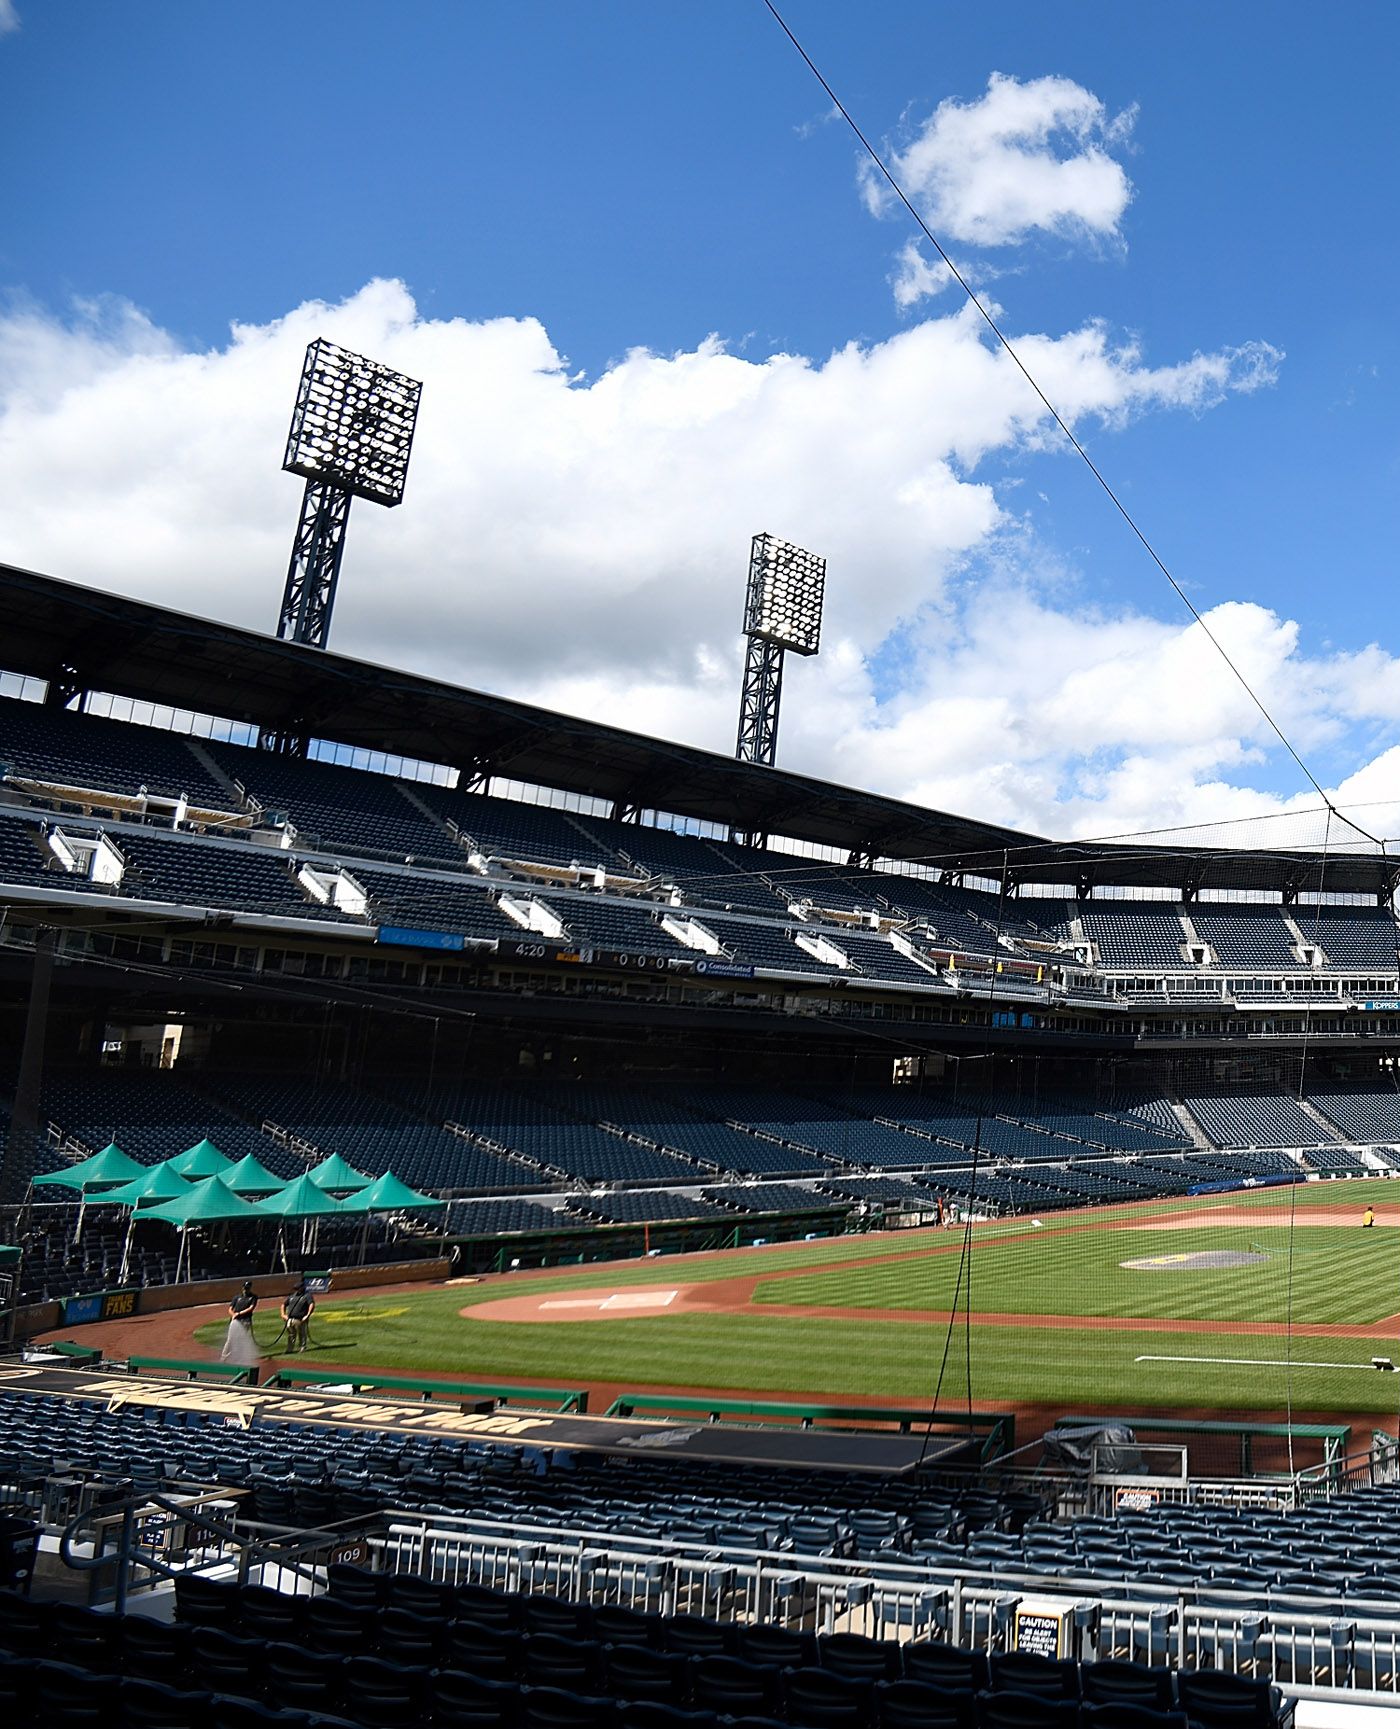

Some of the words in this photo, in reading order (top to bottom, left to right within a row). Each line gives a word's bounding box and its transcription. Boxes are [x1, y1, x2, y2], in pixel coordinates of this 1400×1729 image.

[515, 943, 546, 958] 4:20
[708, 962, 751, 973] Consolidated
[105, 1299, 134, 1316] FANS
[74, 1380, 284, 1406] WELCOME
[303, 1402, 425, 1422] PNC
[400, 1411, 554, 1435] PARK
[338, 1547, 361, 1563] 109
[1019, 1616, 1058, 1630] CAUTION
